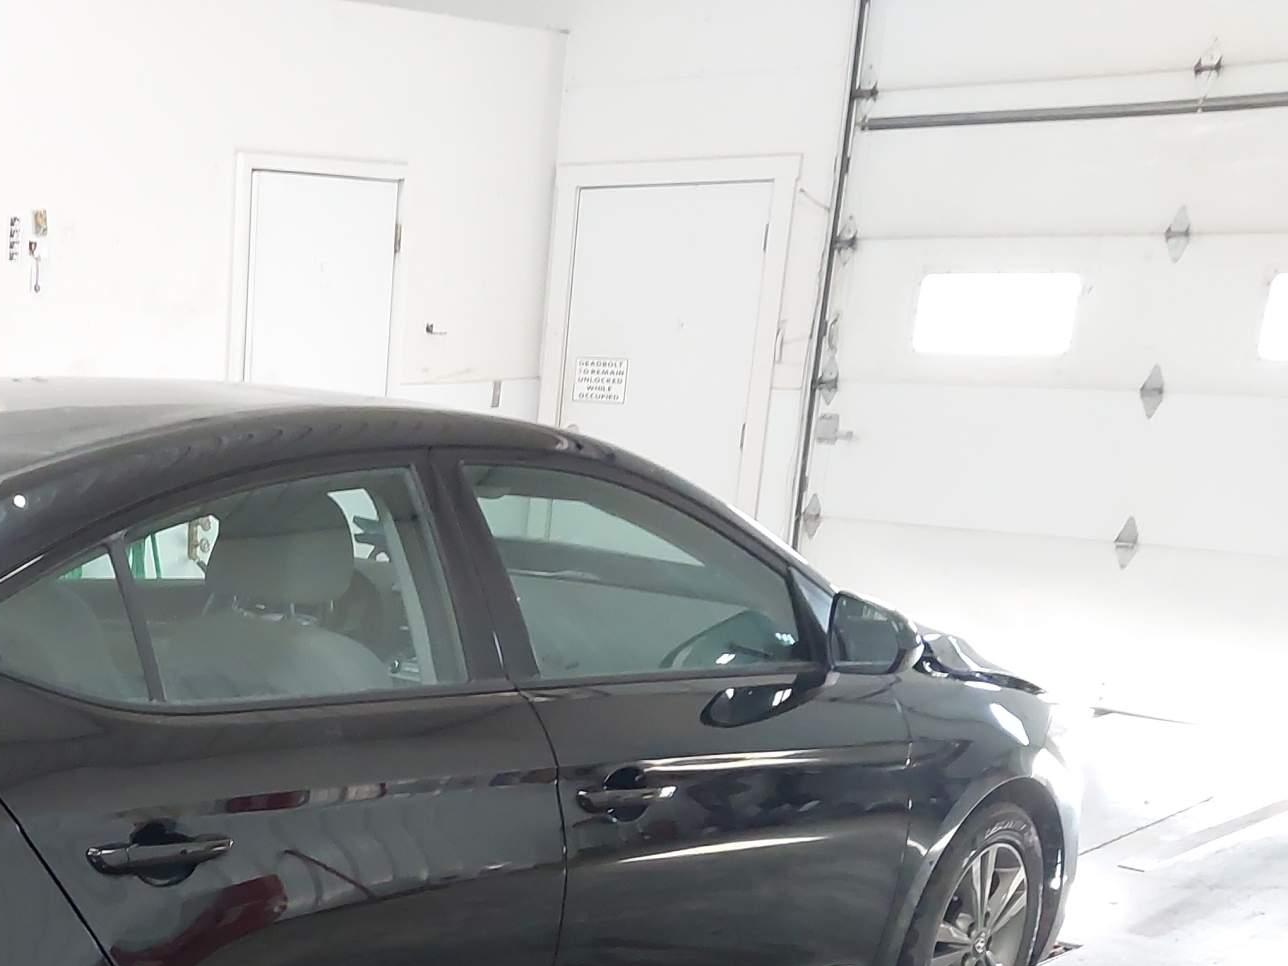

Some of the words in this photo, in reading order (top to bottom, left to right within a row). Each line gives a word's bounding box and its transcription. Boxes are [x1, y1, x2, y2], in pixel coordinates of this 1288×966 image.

[578, 360, 624, 368] DEADBOLT
[577, 376, 623, 384] UNLOCKED
[586, 384, 613, 392] WHILE
[578, 392, 620, 401] OCCUPIED
